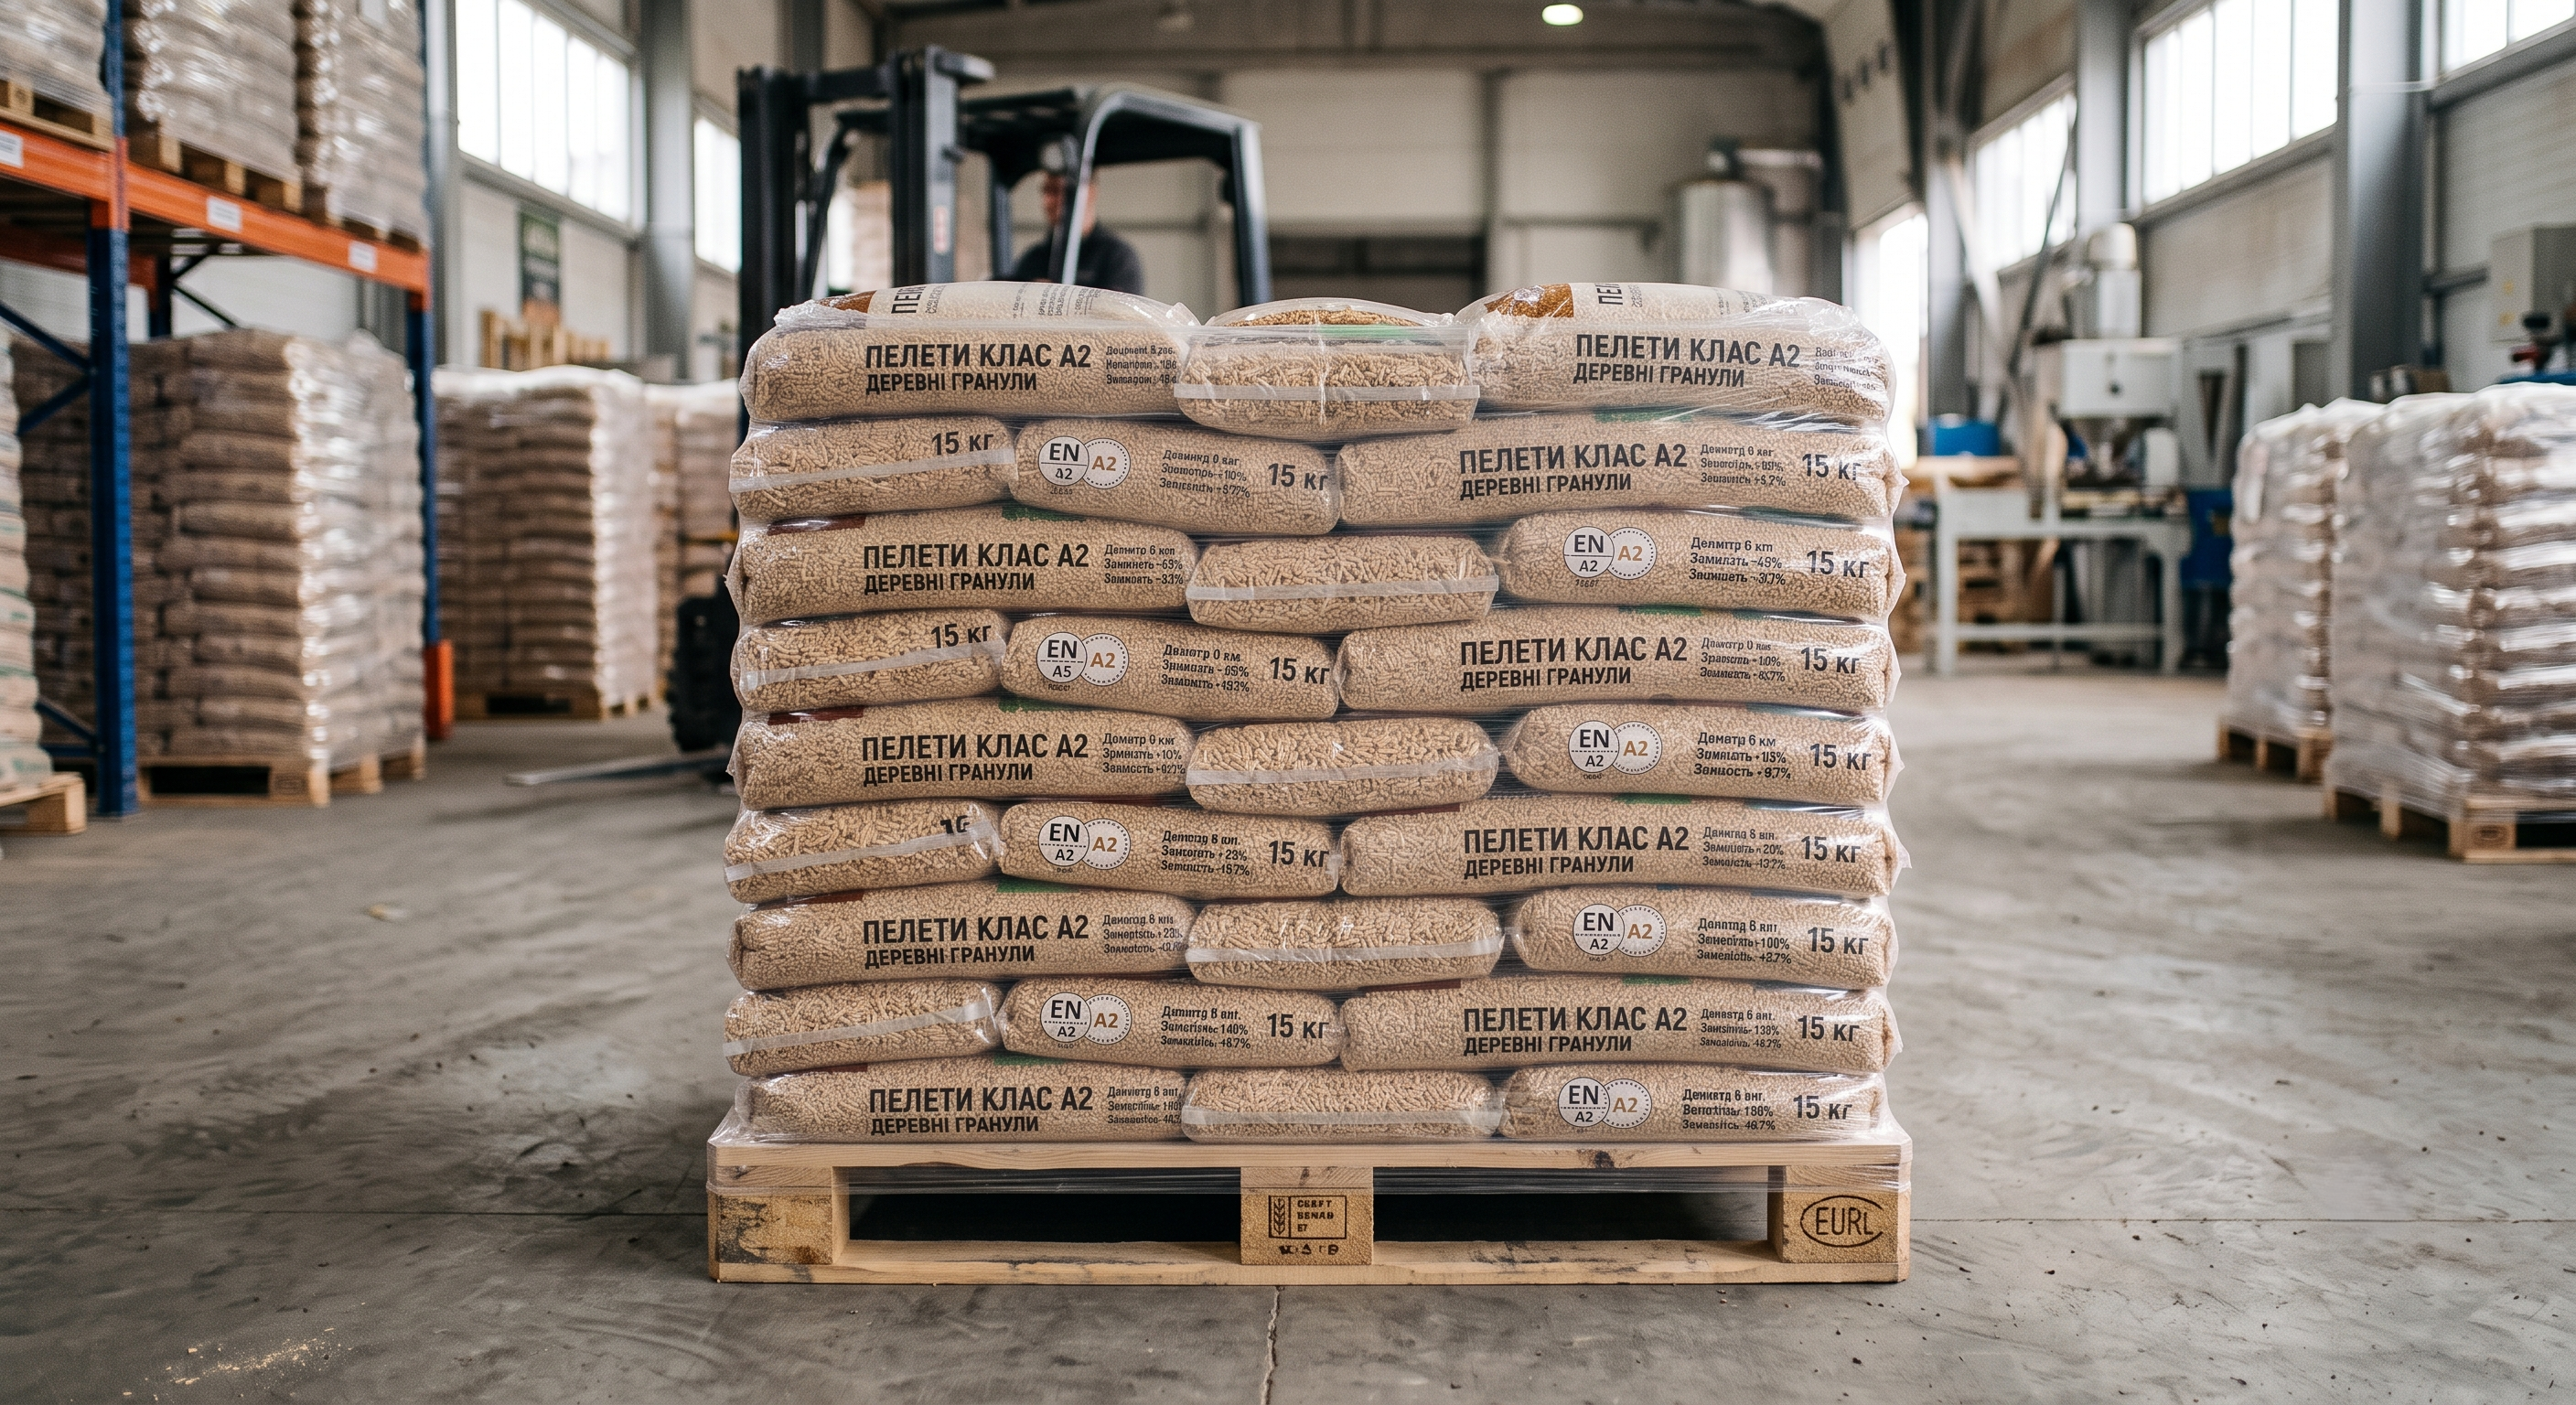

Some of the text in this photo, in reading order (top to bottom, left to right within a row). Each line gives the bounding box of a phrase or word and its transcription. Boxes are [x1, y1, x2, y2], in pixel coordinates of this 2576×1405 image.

[865, 345, 971, 368] ПЕЛЕТИ
[980, 344, 1052, 368] КЛАС
[1059, 345, 1091, 368] А2
[1576, 334, 1799, 368] ПЕЛЕТИ КЛАС А2
[866, 372, 1036, 394] ДЕРЕВНІ ГРАНУЛИ
[1573, 363, 1744, 387] ДЕРЕВНІ ГРАНУЛИ
[932, 432, 993, 456] 15 кг
[1049, 443, 1079, 461] EN
[1092, 456, 1116, 471] A2
[1460, 445, 1564, 474] ПЕЛЕТИ
[1575, 444, 1646, 468] КЛАС
[1655, 444, 1687, 467] А2
[1802, 454, 1829, 477] 15
[1839, 460, 1862, 480] кг
[1268, 463, 1327, 490] 15 кг
[1460, 473, 1631, 500] ДЕРЕВНІ ГРАНУЛИ
[1150, 545, 1155, 554] 6
[1574, 535, 1604, 552] EN
[1617, 546, 1643, 561] A2
[1744, 541, 1752, 551] 6
[864, 543, 1089, 569] ПЕЛЕТИ КЛАС А2
[1579, 560, 1597, 572] A2
[1807, 551, 1869, 578] 15 кг
[864, 573, 1035, 595] ДЕРЕВНІ ГРАНУЛИ
[931, 624, 991, 649] 15 кг
[1047, 640, 1077, 659] EN
[1090, 652, 1115, 669] A2
[1461, 638, 1565, 665] ПЕЛЕТИ
[1575, 637, 1646, 661] КЛАС
[1655, 637, 1687, 660] А2
[1801, 648, 1860, 673] 15 кг
[1053, 666, 1071, 678] A5
[1270, 657, 1330, 684] 15 кг
[1461, 667, 1630, 692] ДЕРЕВНІ ГРАНУЛИ
[862, 735, 966, 761] ПЕЛЕТИ
[977, 734, 1047, 757] КЛАС
[1056, 734, 1088, 757] А2
[1580, 730, 1609, 748] EN
[1624, 741, 1648, 756] A2
[1749, 735, 1755, 745] 6
[1585, 755, 1604, 767] A2
[1810, 744, 1871, 770] 15 кг
[864, 764, 1032, 787] ДЕРЕВНІ ГРАНУЛИ
[1049, 823, 1079, 842] EN
[1465, 828, 1567, 853] ПЕЛЕТИ
[1578, 826, 1648, 850] КЛАС
[1657, 827, 1689, 850] А2
[1055, 849, 1074, 861] A2
[1092, 837, 1117, 853] A2
[1269, 841, 1329, 867] 15 кг
[1801, 836, 1861, 863] 15 кг
[1464, 856, 1634, 880] ДЕРЕВНІ ГРАНУЛИ
[864, 917, 966, 944] ПЕЛЕТИ
[979, 916, 1048, 941] КЛАС
[1057, 915, 1089, 939] А2
[1583, 913, 1614, 931] EN
[1627, 924, 1652, 938] A2
[1590, 938, 1608, 949] A2
[1808, 928, 1868, 954] 15 кг
[864, 946, 1035, 970] ДЕРЕВНІ ГРАНУЛИ
[1051, 1000, 1081, 1019] EN
[1094, 1013, 1118, 1028] A2
[1464, 1006, 1687, 1032] ПЕЛЕТИ КЛАС А2
[1747, 1010, 1753, 1020] 6
[1057, 1026, 1076, 1037] A2
[1267, 1014, 1329, 1038] 15 кг
[1798, 1015, 1860, 1042] 15 кг
[1464, 1036, 1631, 1056] ДЕРЕВНІ ГРАНУЛИ
[870, 1088, 971, 1113] ПЕЛЕТИ
[982, 1088, 1052, 1111] КЛАС
[1061, 1087, 1092, 1110] А2
[1569, 1086, 1599, 1105] EN
[1613, 1098, 1637, 1112] A2
[1575, 1111, 1594, 1122] A2
[1794, 1095, 1852, 1120] 15 кг
[871, 1117, 1038, 1136] ДЕРЕВНІ ГРАНУЛИ
